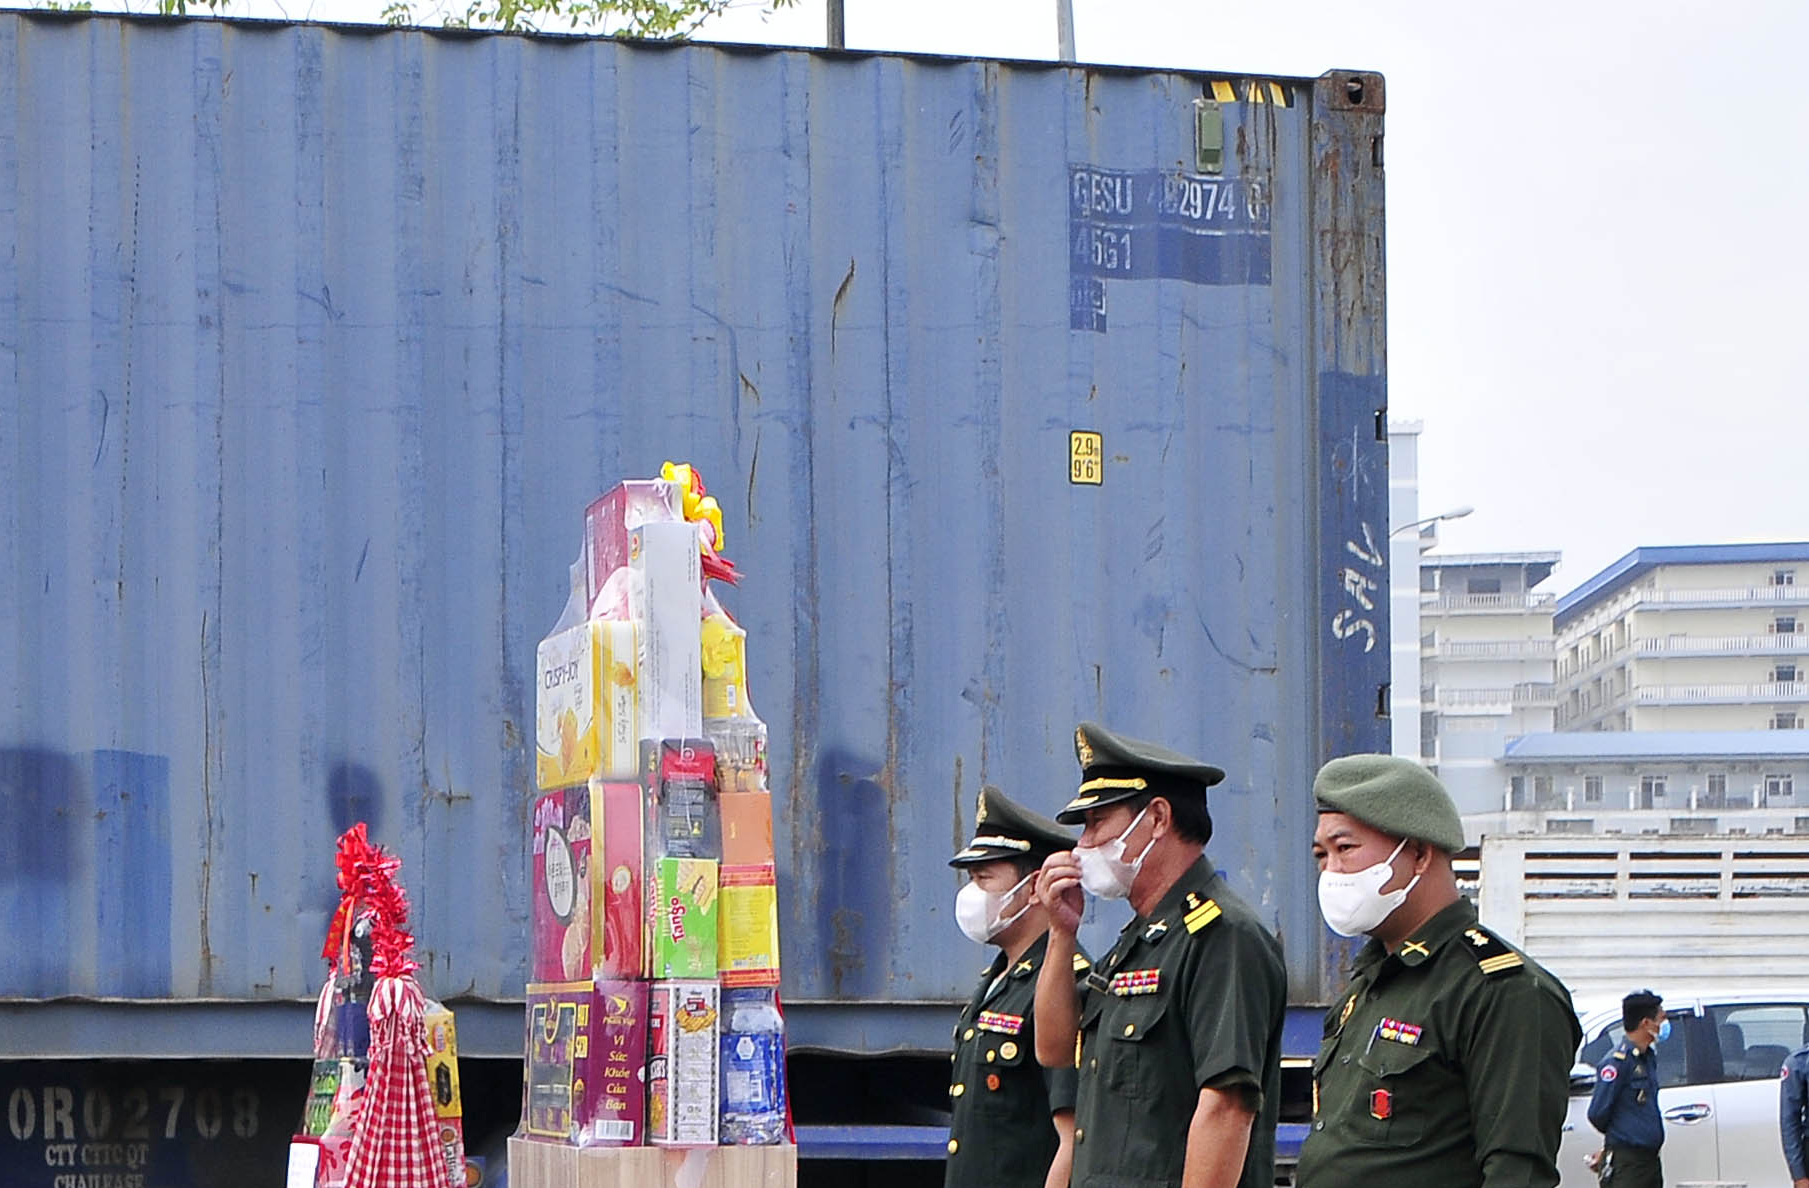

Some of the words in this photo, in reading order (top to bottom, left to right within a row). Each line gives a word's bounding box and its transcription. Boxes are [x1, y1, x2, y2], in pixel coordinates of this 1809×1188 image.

[1072, 172, 1133, 215] GESU
[670, 896, 687, 944] Tango
[45, 1145, 78, 1166] CTY
